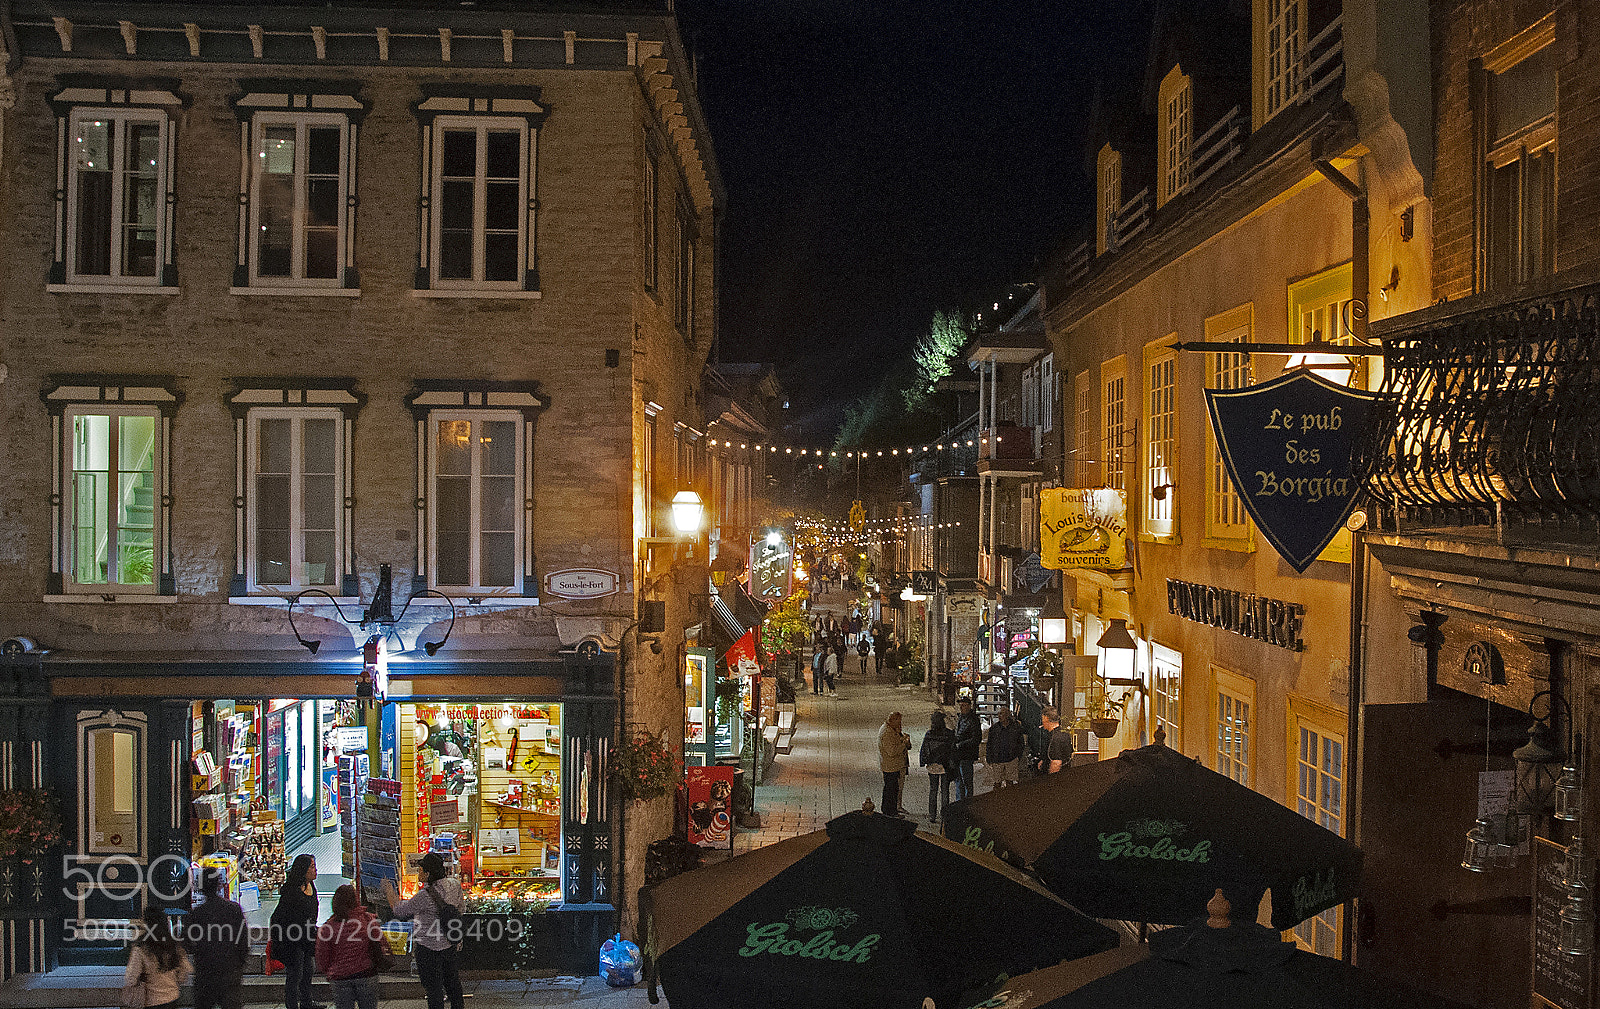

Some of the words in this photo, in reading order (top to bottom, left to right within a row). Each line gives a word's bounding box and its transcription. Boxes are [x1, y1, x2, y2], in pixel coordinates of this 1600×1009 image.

[1264, 407, 1294, 430] Le
[1300, 406, 1342, 435] pub
[1285, 439, 1321, 464] des
[1255, 469, 1350, 503] Borgia
[1044, 512, 1084, 537] Louis
[1057, 554, 1111, 567] souvenirs
[559, 581, 604, 589] Sous-le-Fort
[1166, 577, 1308, 653] FUNICULAIRE
[1472, 662, 1481, 675] 12
[1097, 831, 1212, 864] Grolsch
[738, 922, 882, 963] Grolsch
